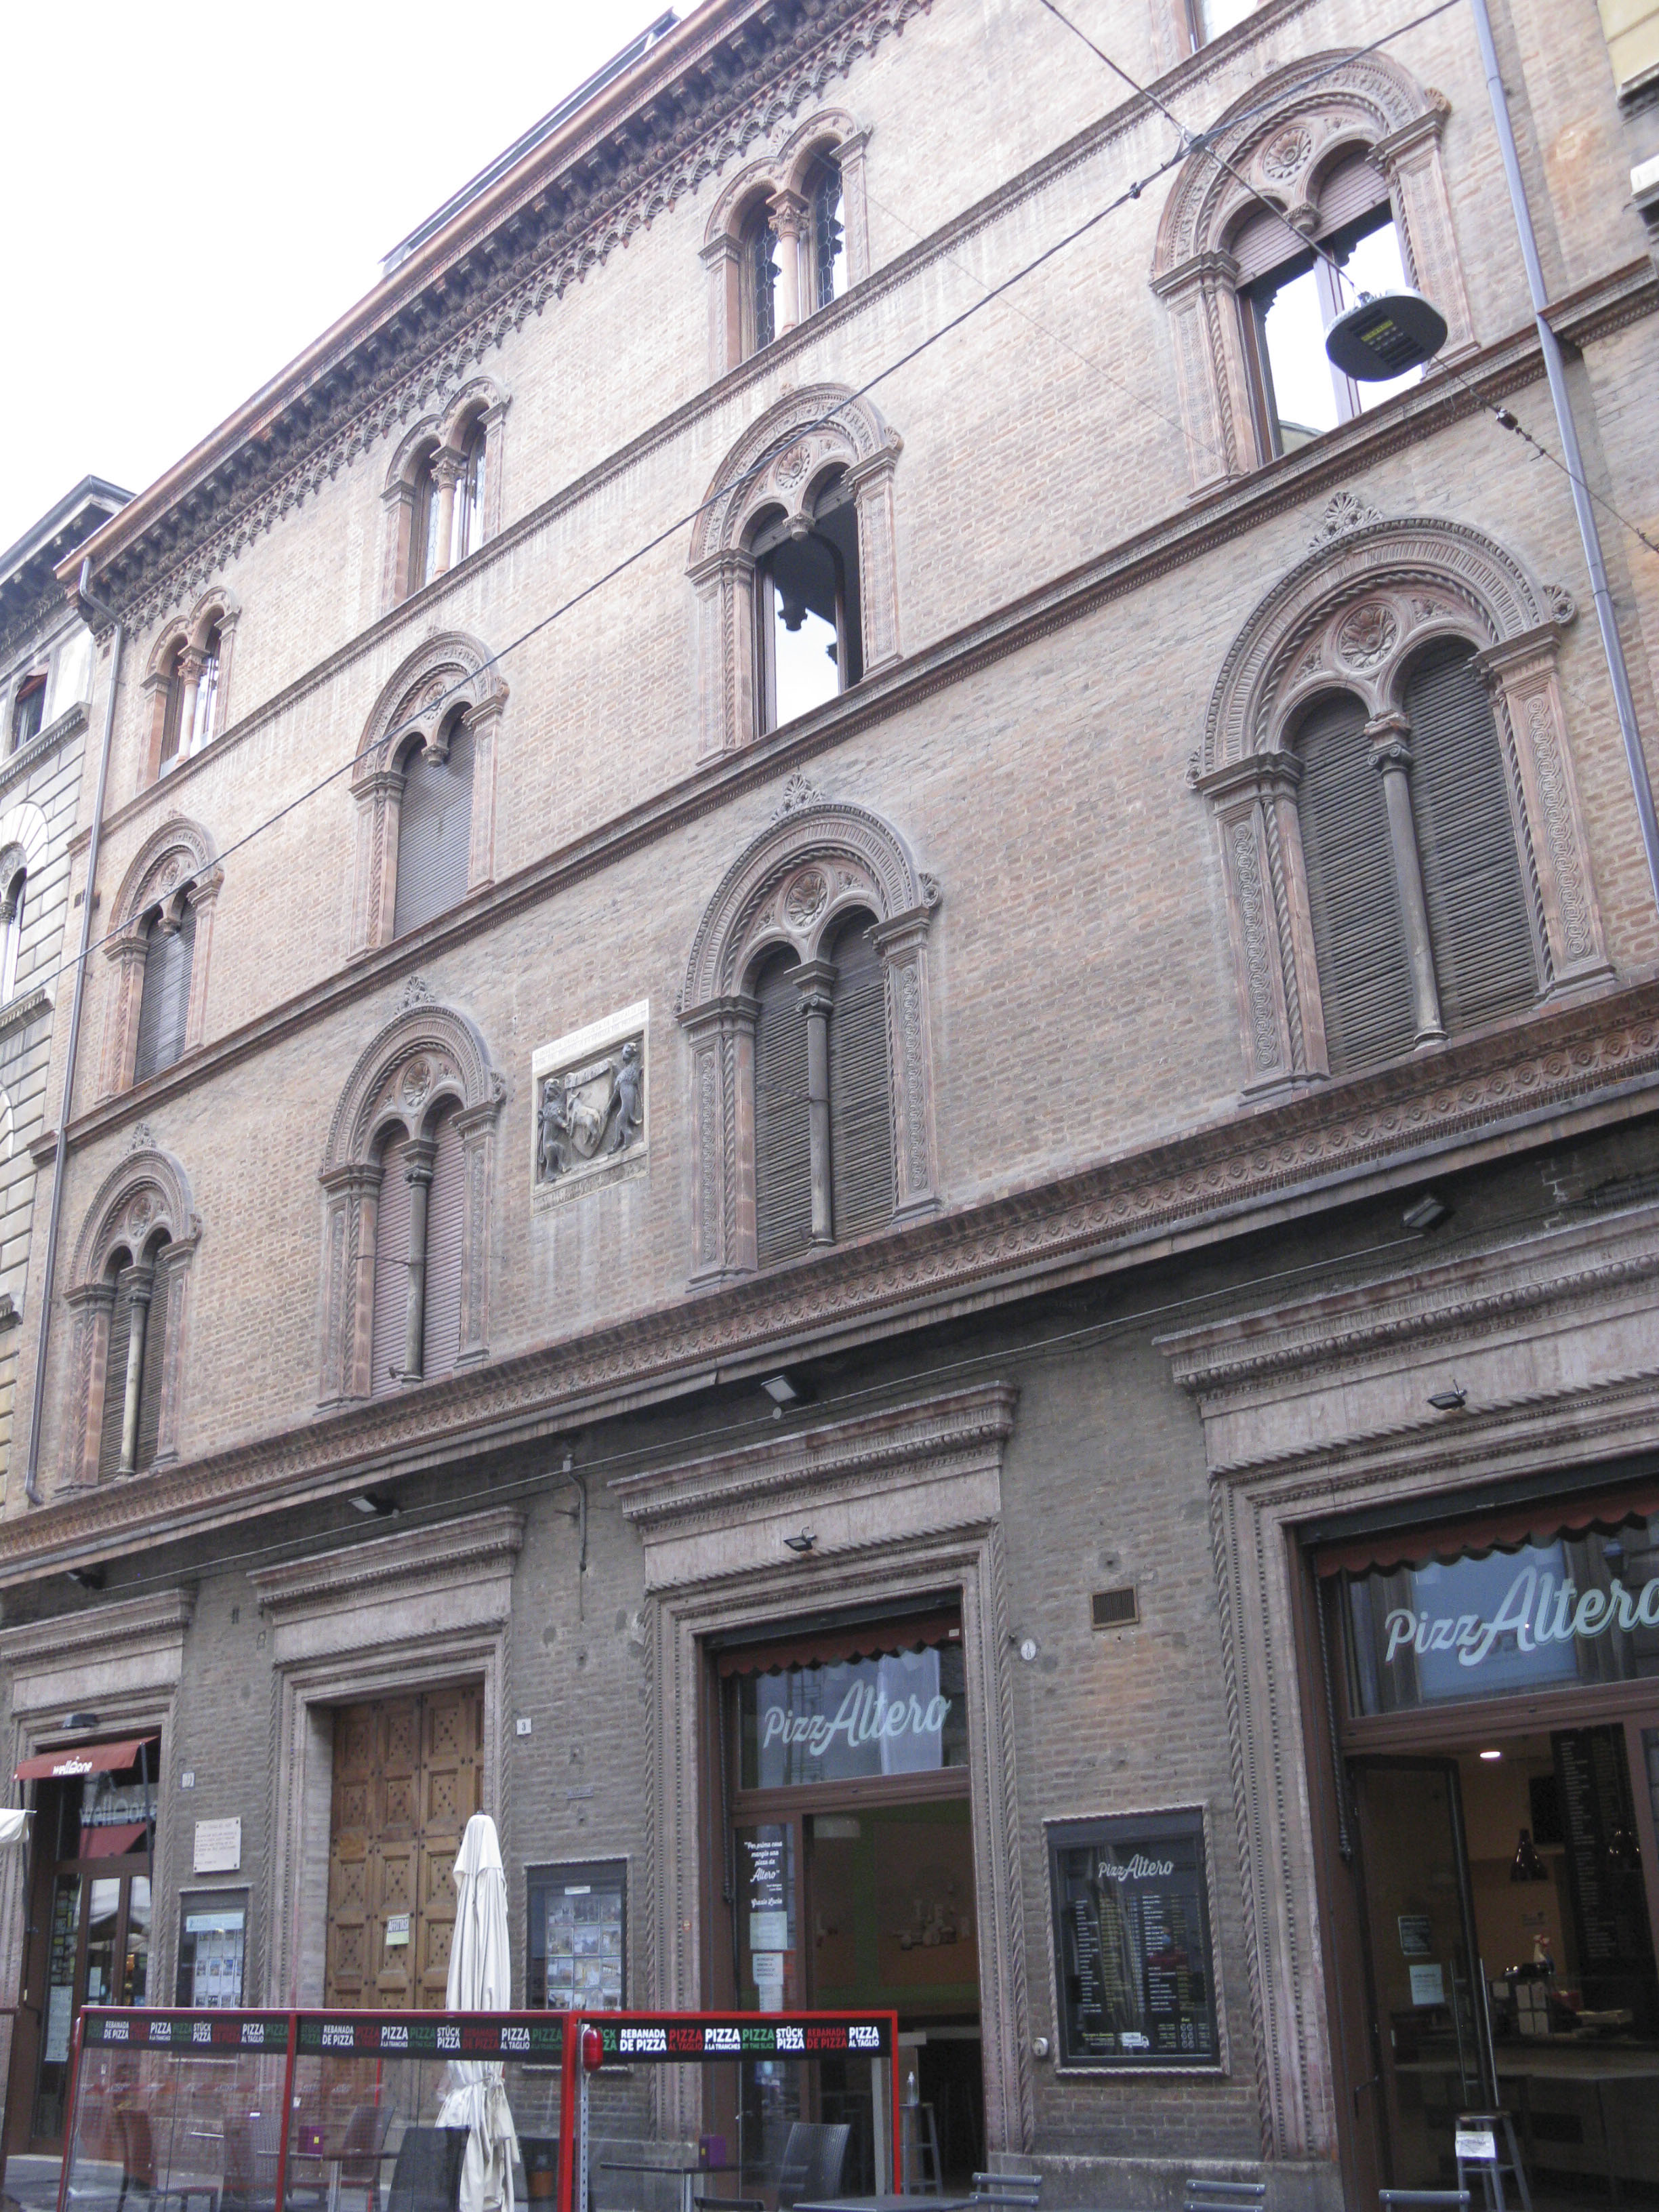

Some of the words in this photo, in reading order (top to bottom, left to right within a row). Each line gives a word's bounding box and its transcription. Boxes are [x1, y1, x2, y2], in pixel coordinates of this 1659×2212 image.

[763, 1679, 951, 1757] PizzAltero
[1099, 1853, 1174, 1882] PizzAltero
[106, 2021, 129, 2029] REBANADA
[150, 2022, 171, 2034] PIZZA
[193, 2020, 212, 2032] STÜCK
[243, 2023, 264, 2036] PIZZA
[323, 2025, 354, 2034] REBANADA
[437, 2025, 460, 2037] STÜCK
[104, 2029, 112, 2039] DE
[112, 2029, 129, 2039] PIZZA
[192, 2032, 211, 2042] PIZZA
[382, 2026, 408, 2040] PIZZA
[410, 2027, 435, 2040] PIZZA
[501, 2028, 530, 2041] PIZZA
[532, 2028, 562, 2041] PIZZA
[621, 2028, 666, 2039] REBANADA
[669, 2028, 703, 2042] PIZZA
[705, 2028, 741, 2043] PIZZA
[742, 2028, 775, 2041] PIZZA
[776, 2026, 803, 2039] STÜCK
[807, 2028, 846, 2037] REBANADA
[849, 2026, 879, 2039] PIZZA
[248, 2035, 264, 2043] TAGLIO
[322, 2034, 331, 2045] DE
[333, 2035, 354, 2046] PIZZA
[437, 2037, 461, 2049] PIZZA
[476, 2039, 499, 2050] PIZZA
[619, 2040, 634, 2051] DE
[636, 2039, 667, 2051] PIZZA
[777, 2038, 804, 2049] PIZZA
[806, 2038, 819, 2049] DE
[821, 2038, 847, 2049] PIZZA
[857, 2039, 879, 2047] TAGLIO
[509, 2042, 530, 2050] TAGLIO
[668, 2043, 676, 2051] AL
[678, 2043, 703, 2051] TAGLIO
